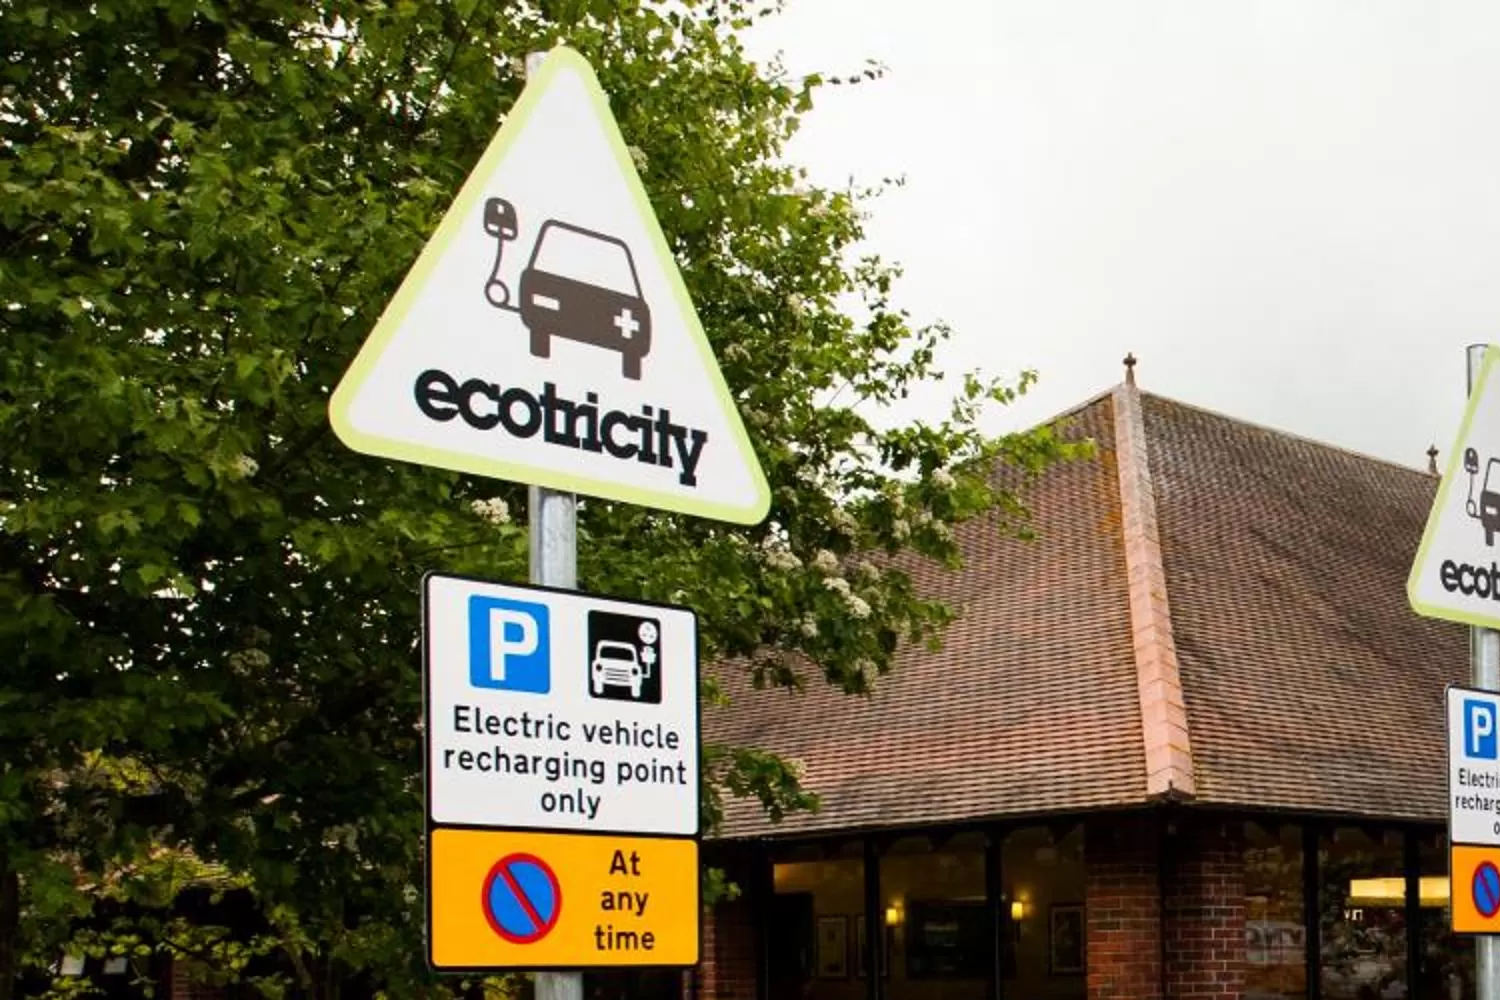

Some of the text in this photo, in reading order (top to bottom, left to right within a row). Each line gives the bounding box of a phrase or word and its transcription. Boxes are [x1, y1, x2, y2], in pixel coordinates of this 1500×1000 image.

[414, 368, 708, 487] ecotricity
[488, 607, 540, 681] P
[454, 704, 680, 750] Electric vehicle
[1471, 706, 1493, 753] P
[443, 747, 687, 786] recharging point
[540, 788, 602, 820] only
[608, 849, 641, 877] At
[600, 890, 649, 917] any
[594, 924, 655, 951] time
